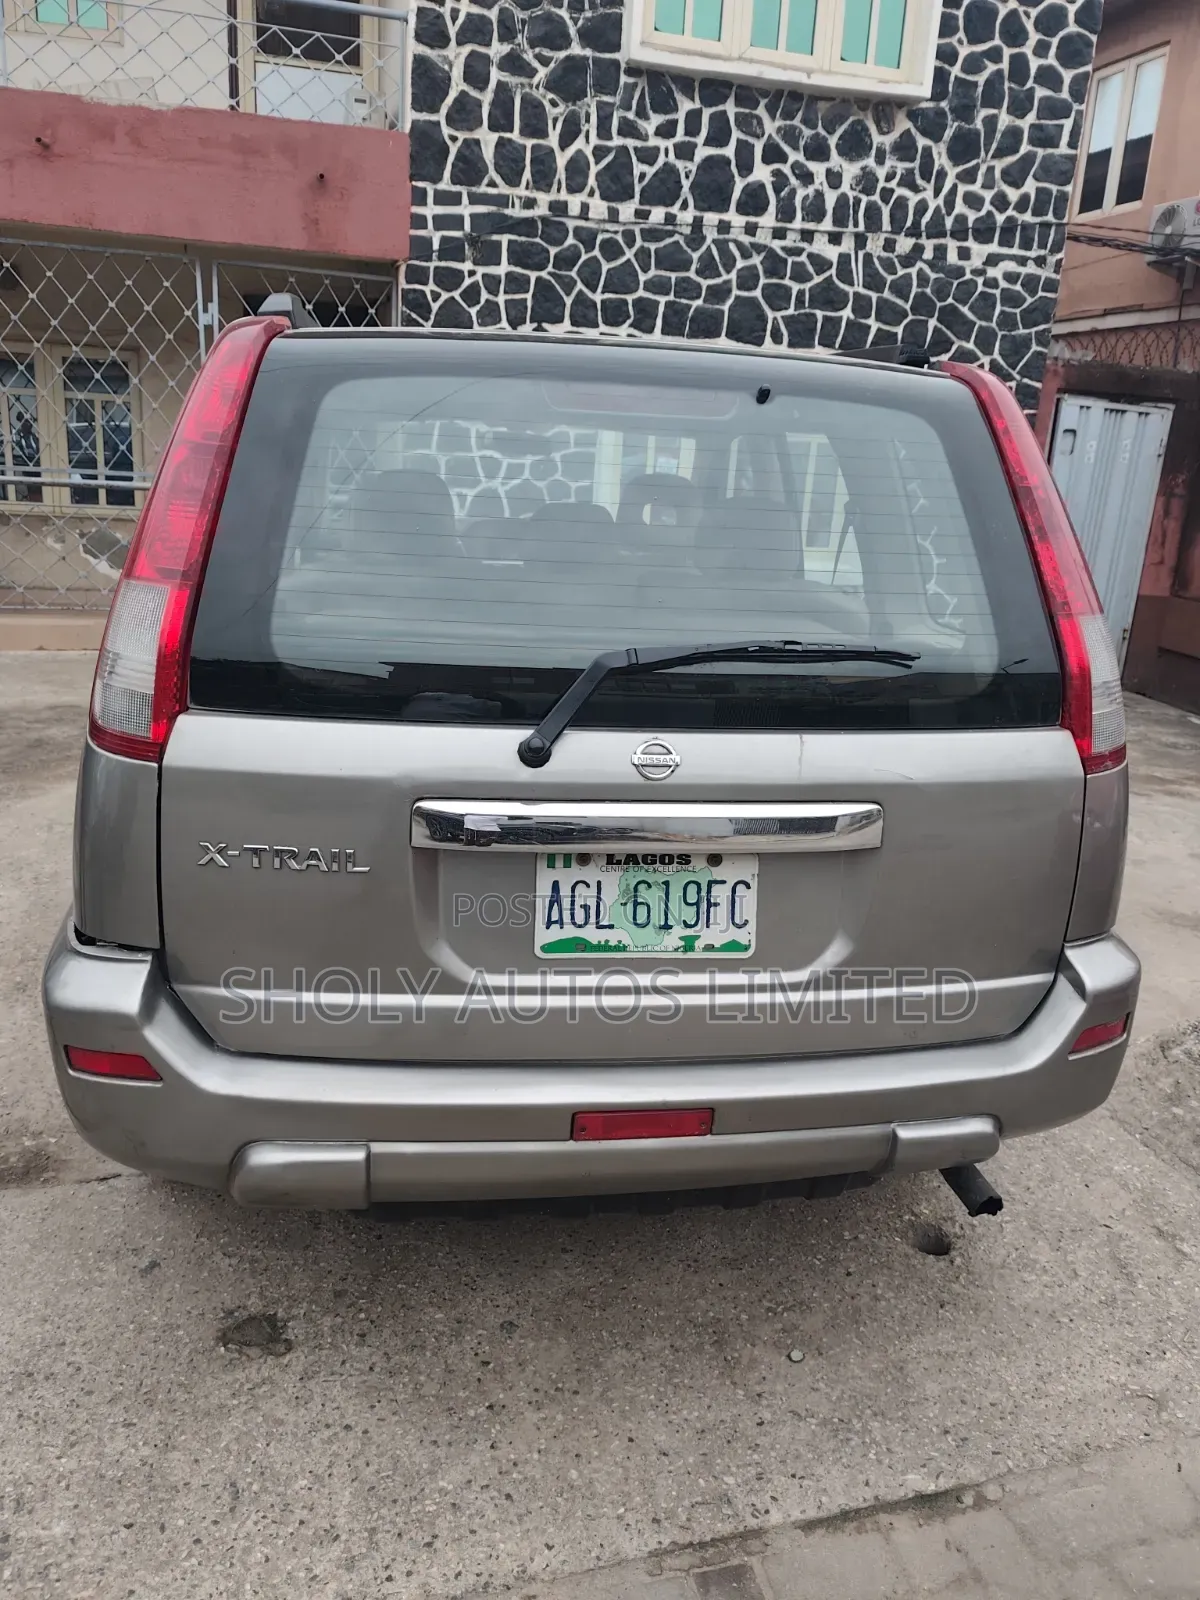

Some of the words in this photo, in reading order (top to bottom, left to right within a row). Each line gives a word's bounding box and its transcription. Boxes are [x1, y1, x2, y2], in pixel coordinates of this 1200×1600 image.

[637, 756, 676, 764] NISSAN
[197, 841, 371, 873] X-TRAIL
[605, 853, 692, 866] LAGOS
[600, 865, 629, 873] CENTRE
[632, 865, 644, 873] OF
[646, 865, 697, 873] EXCELLENCE
